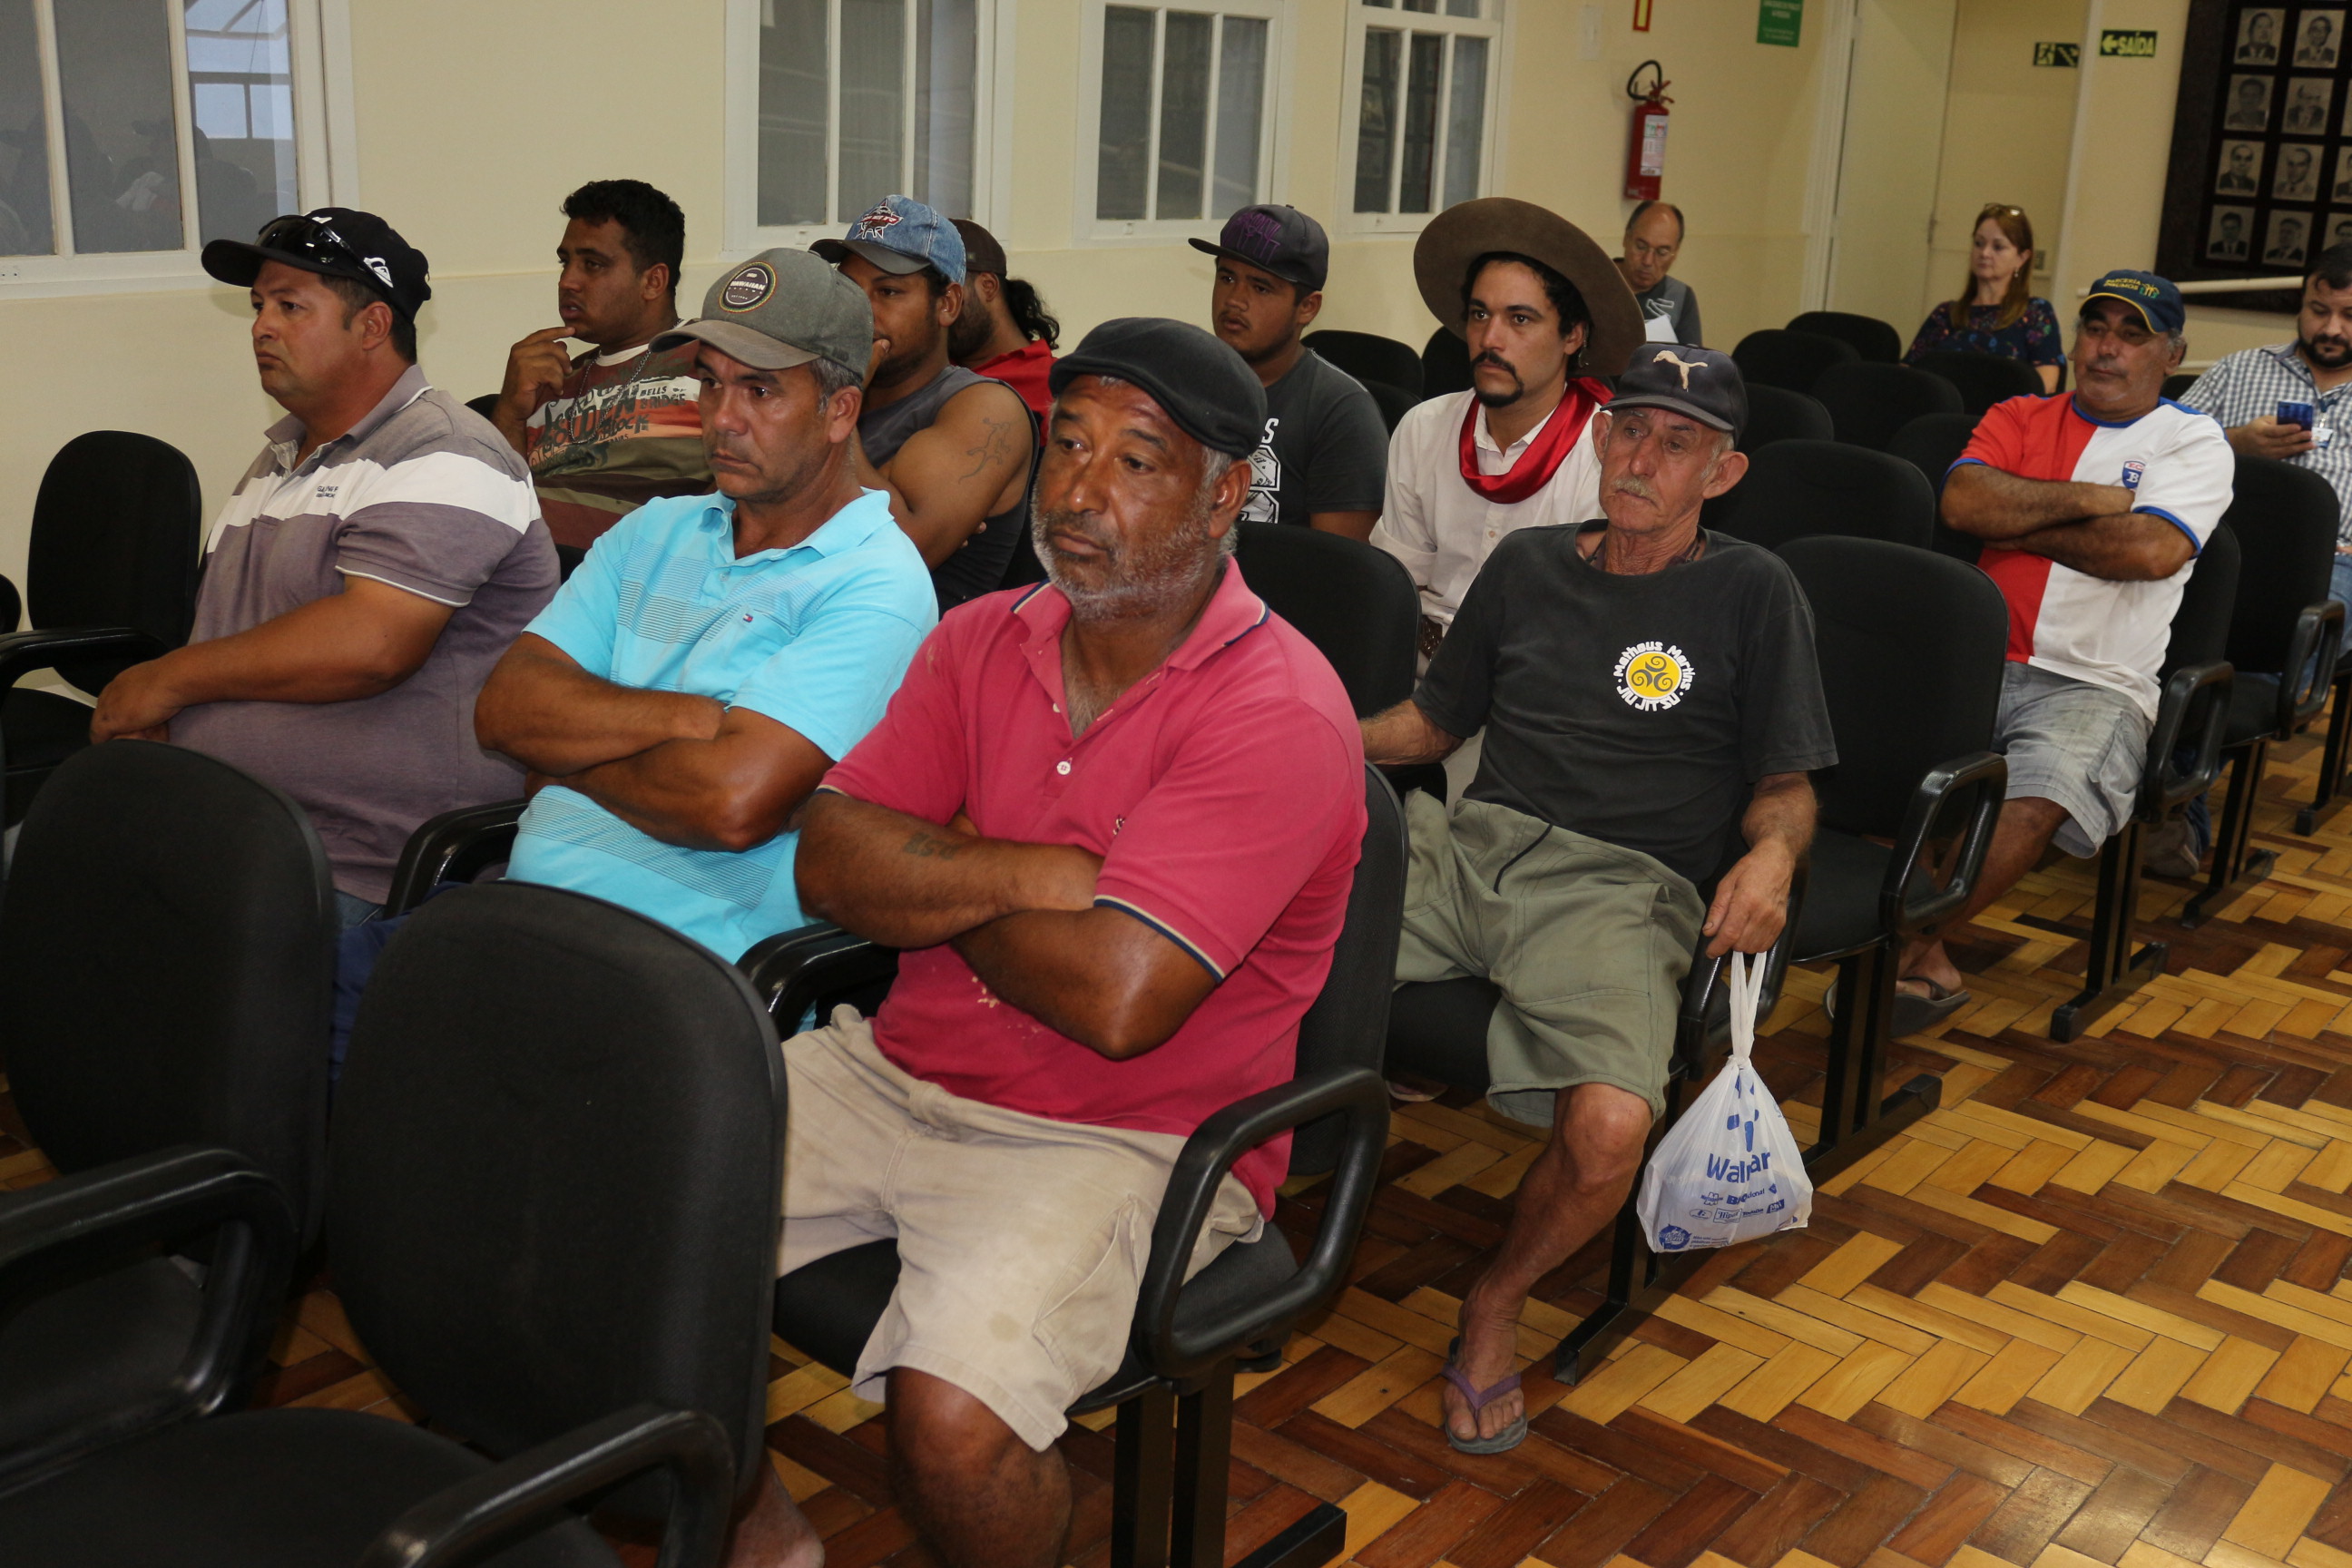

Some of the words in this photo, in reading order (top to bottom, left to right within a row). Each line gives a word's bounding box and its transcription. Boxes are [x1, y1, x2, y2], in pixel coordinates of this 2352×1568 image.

[2117, 31, 2154, 55] SAÍDA
[640, 385, 668, 397] BELLS
[1666, 644, 1696, 691] Martins
